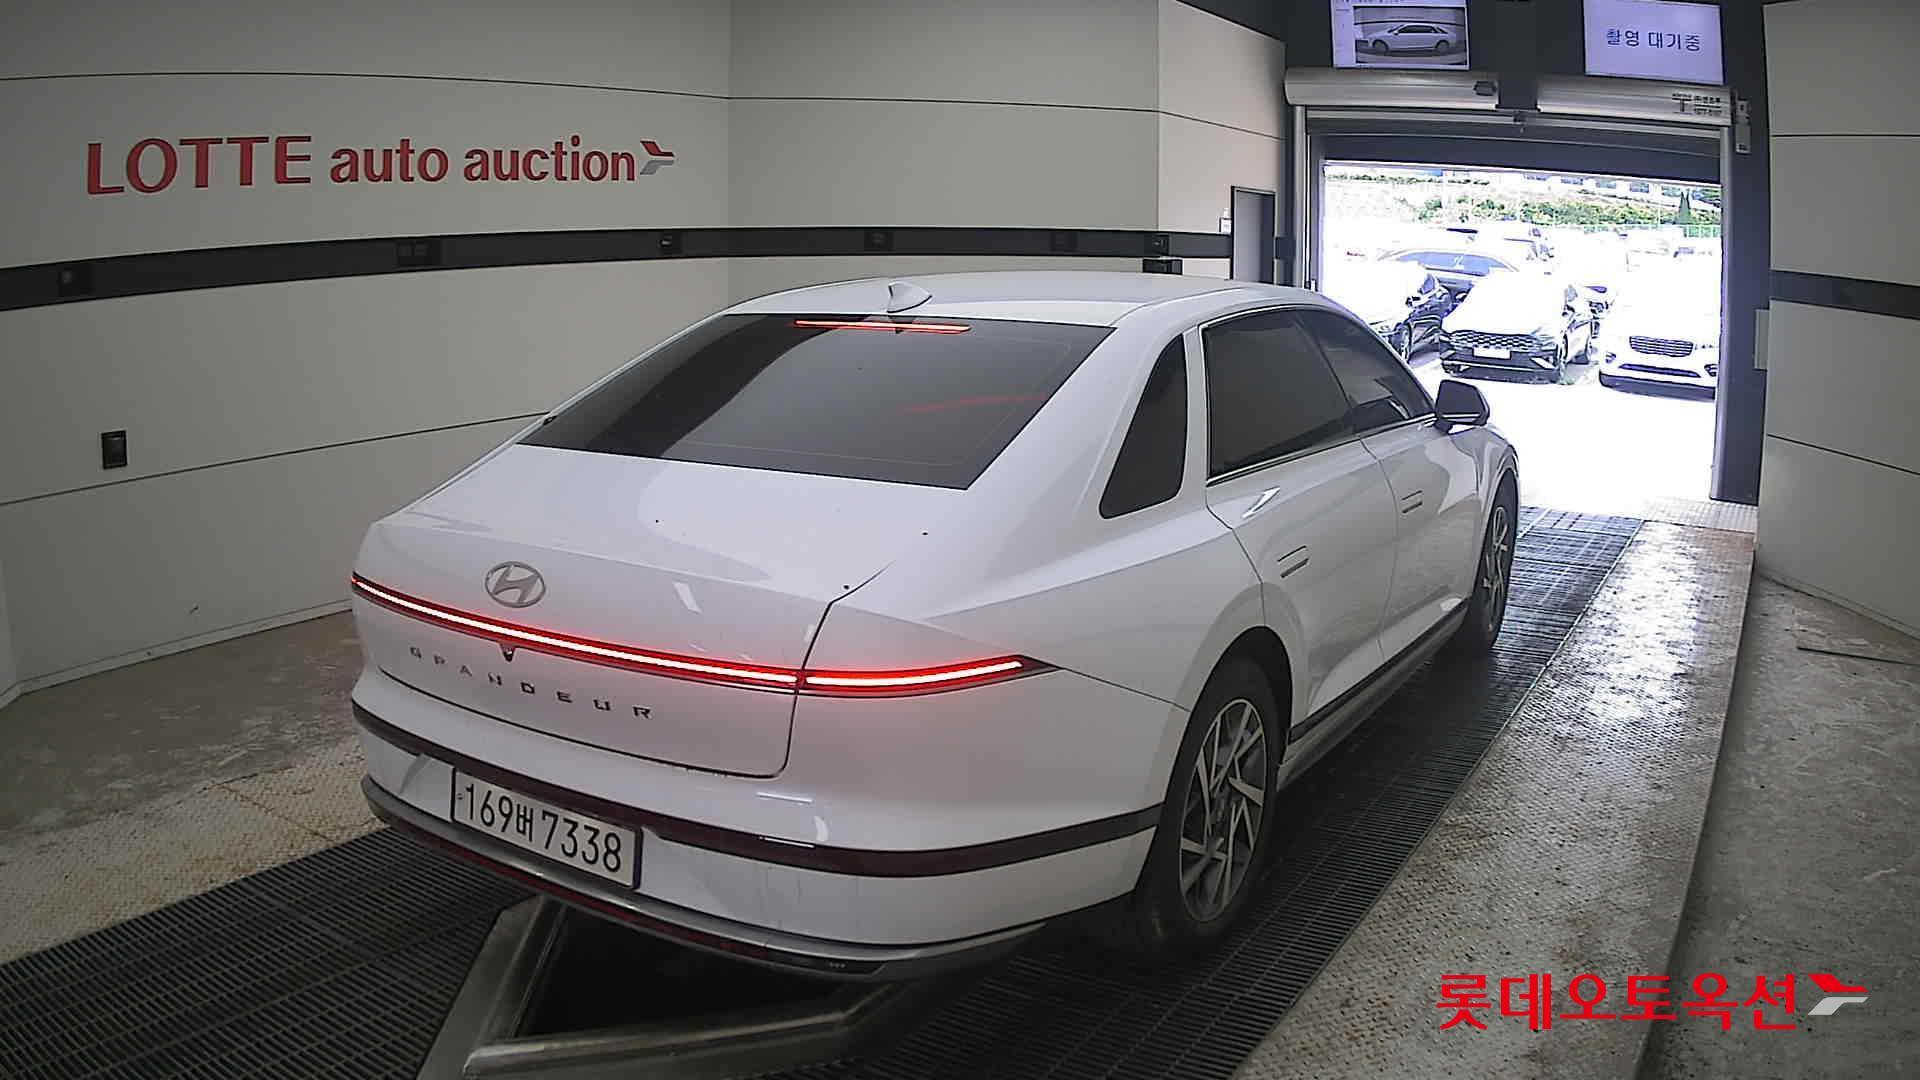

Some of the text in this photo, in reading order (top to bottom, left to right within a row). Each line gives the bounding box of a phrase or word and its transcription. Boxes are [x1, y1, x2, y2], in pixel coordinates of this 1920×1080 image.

[1648, 32, 1700, 52] 대기중
[87, 135, 636, 195] LOTTE auto auction
[410, 647, 651, 719] GRANDEUR
[466, 783, 622, 873] 169버7338
